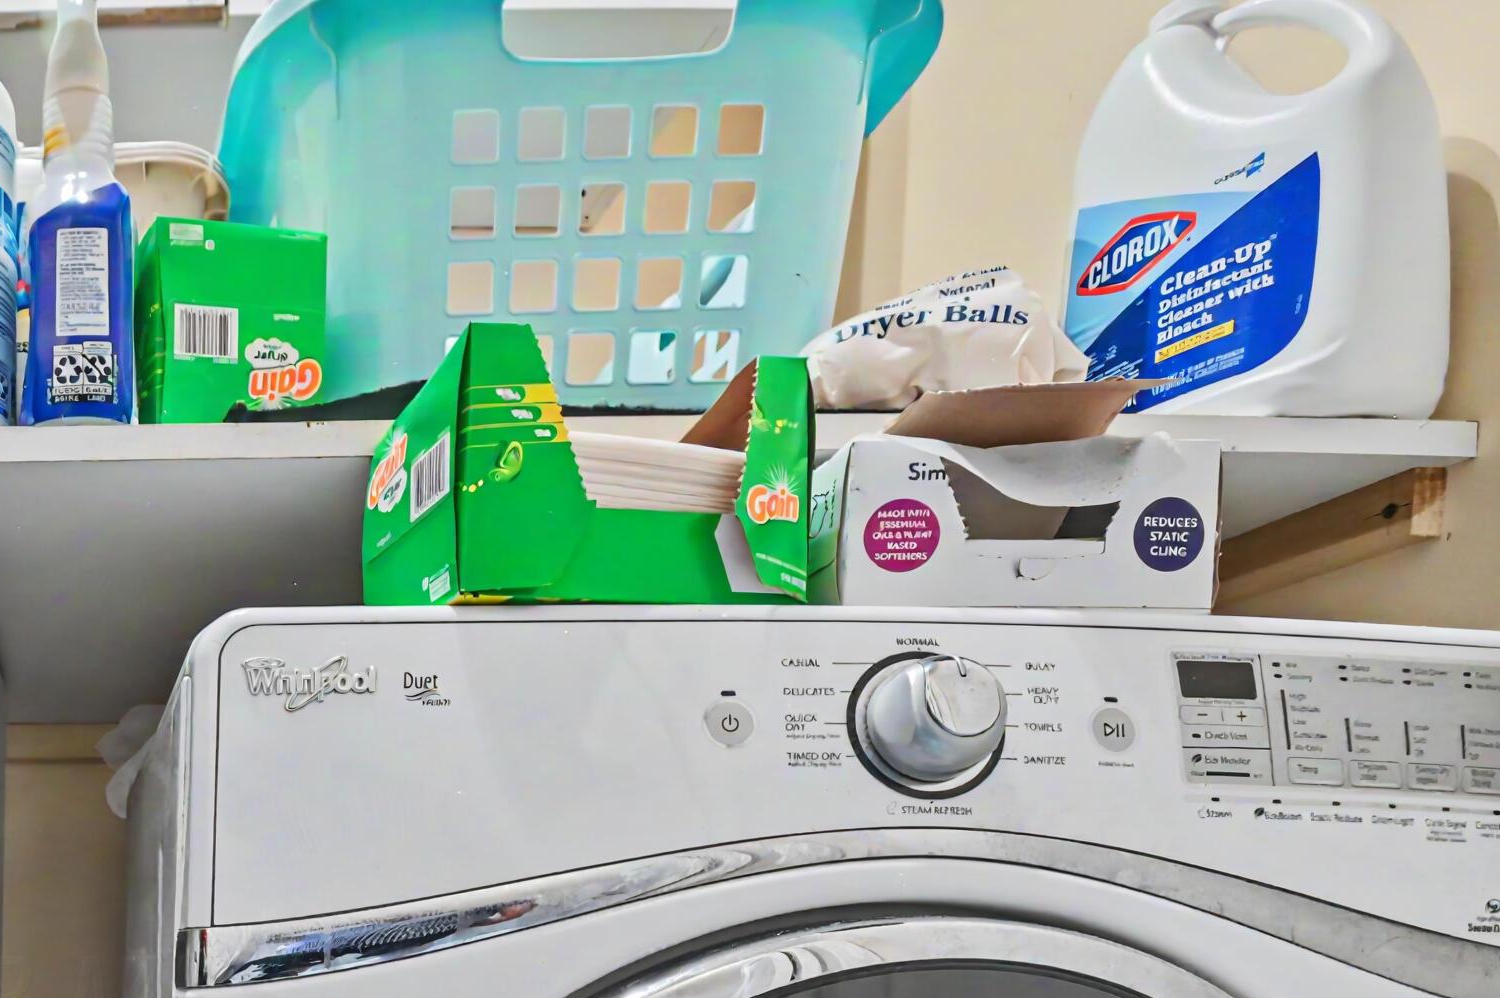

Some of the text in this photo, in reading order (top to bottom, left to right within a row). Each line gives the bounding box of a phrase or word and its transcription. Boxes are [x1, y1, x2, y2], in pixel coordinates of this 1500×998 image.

[1087, 214, 1180, 291] CLOROX
[1160, 240, 1273, 295] Clean-Up
[1228, 274, 1275, 299] with
[835, 309, 933, 344] Dryer
[942, 304, 1029, 326] Balls
[249, 360, 322, 400] Gain
[747, 485, 799, 524] Gain
[1143, 516, 1198, 528] REDUCES
[1149, 531, 1190, 542] STATIC
[1150, 546, 1187, 557] CLING
[244, 659, 378, 706] Whirlpool
[403, 671, 438, 690] Duet
